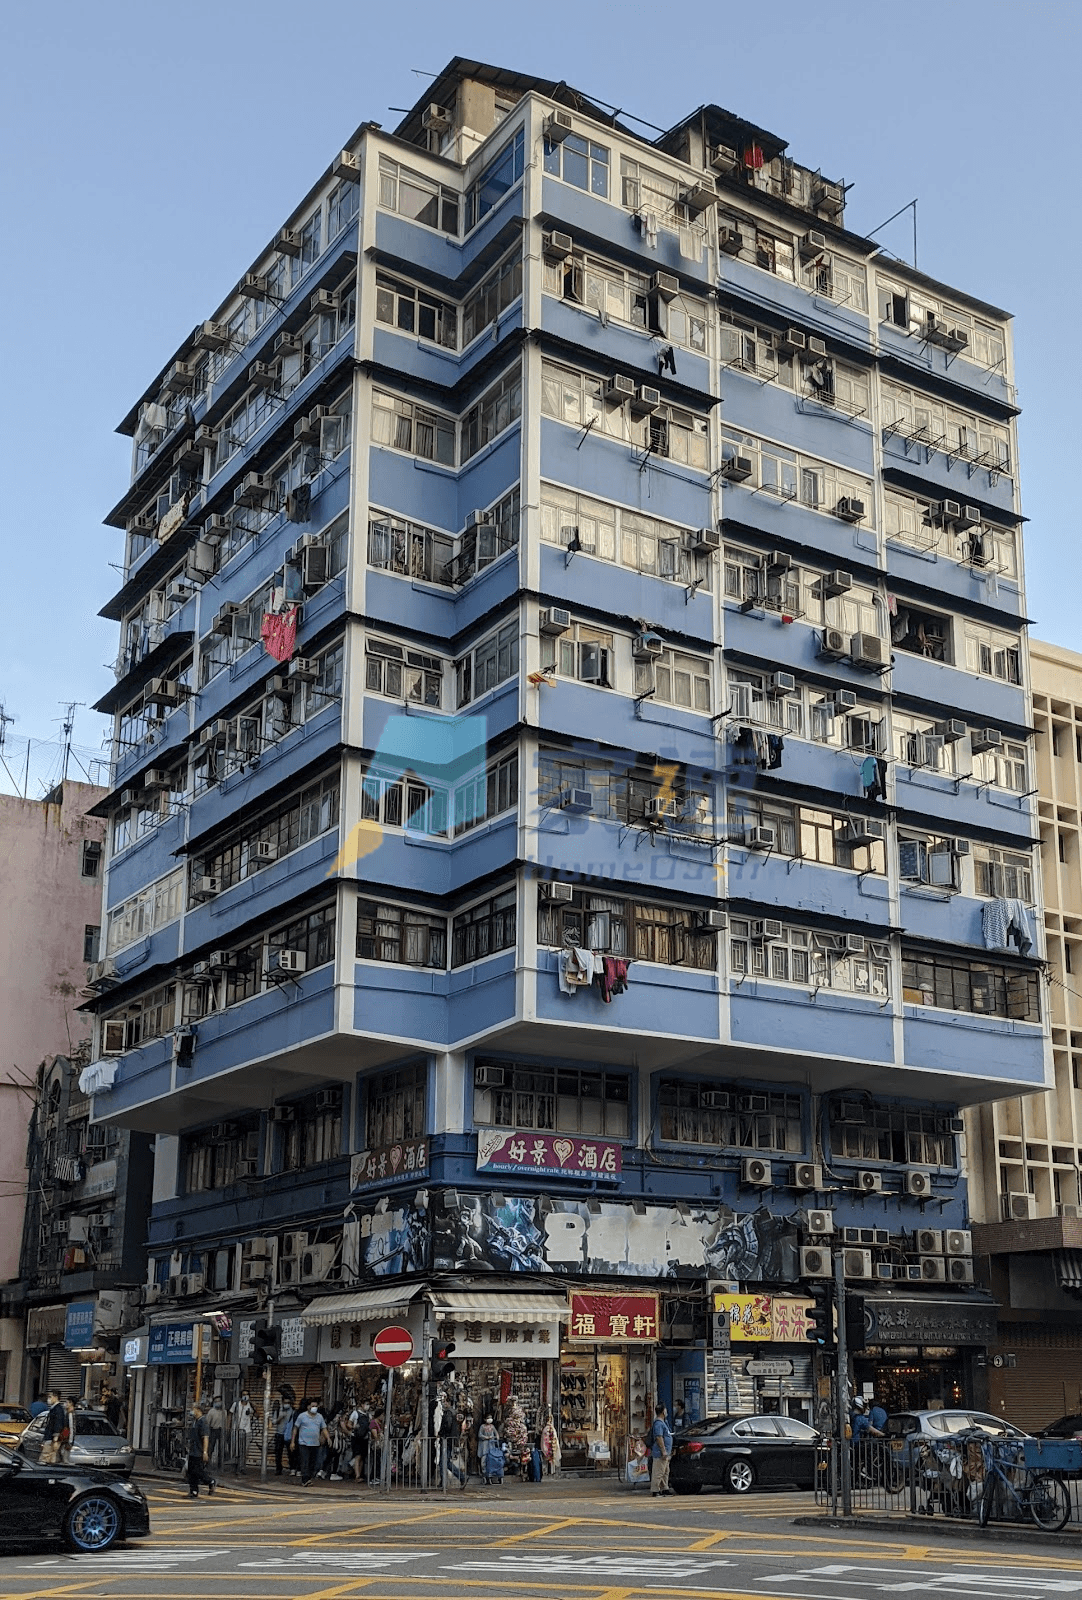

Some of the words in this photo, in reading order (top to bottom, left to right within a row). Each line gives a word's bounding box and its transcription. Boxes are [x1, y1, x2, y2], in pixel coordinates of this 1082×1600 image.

[366, 1152, 388, 1179] 好景
[403, 1143, 426, 1170] 酒店
[507, 1139, 548, 1165] 好景
[577, 1144, 617, 1171] 酒店
[572, 1314, 655, 1337] 福寶軒
